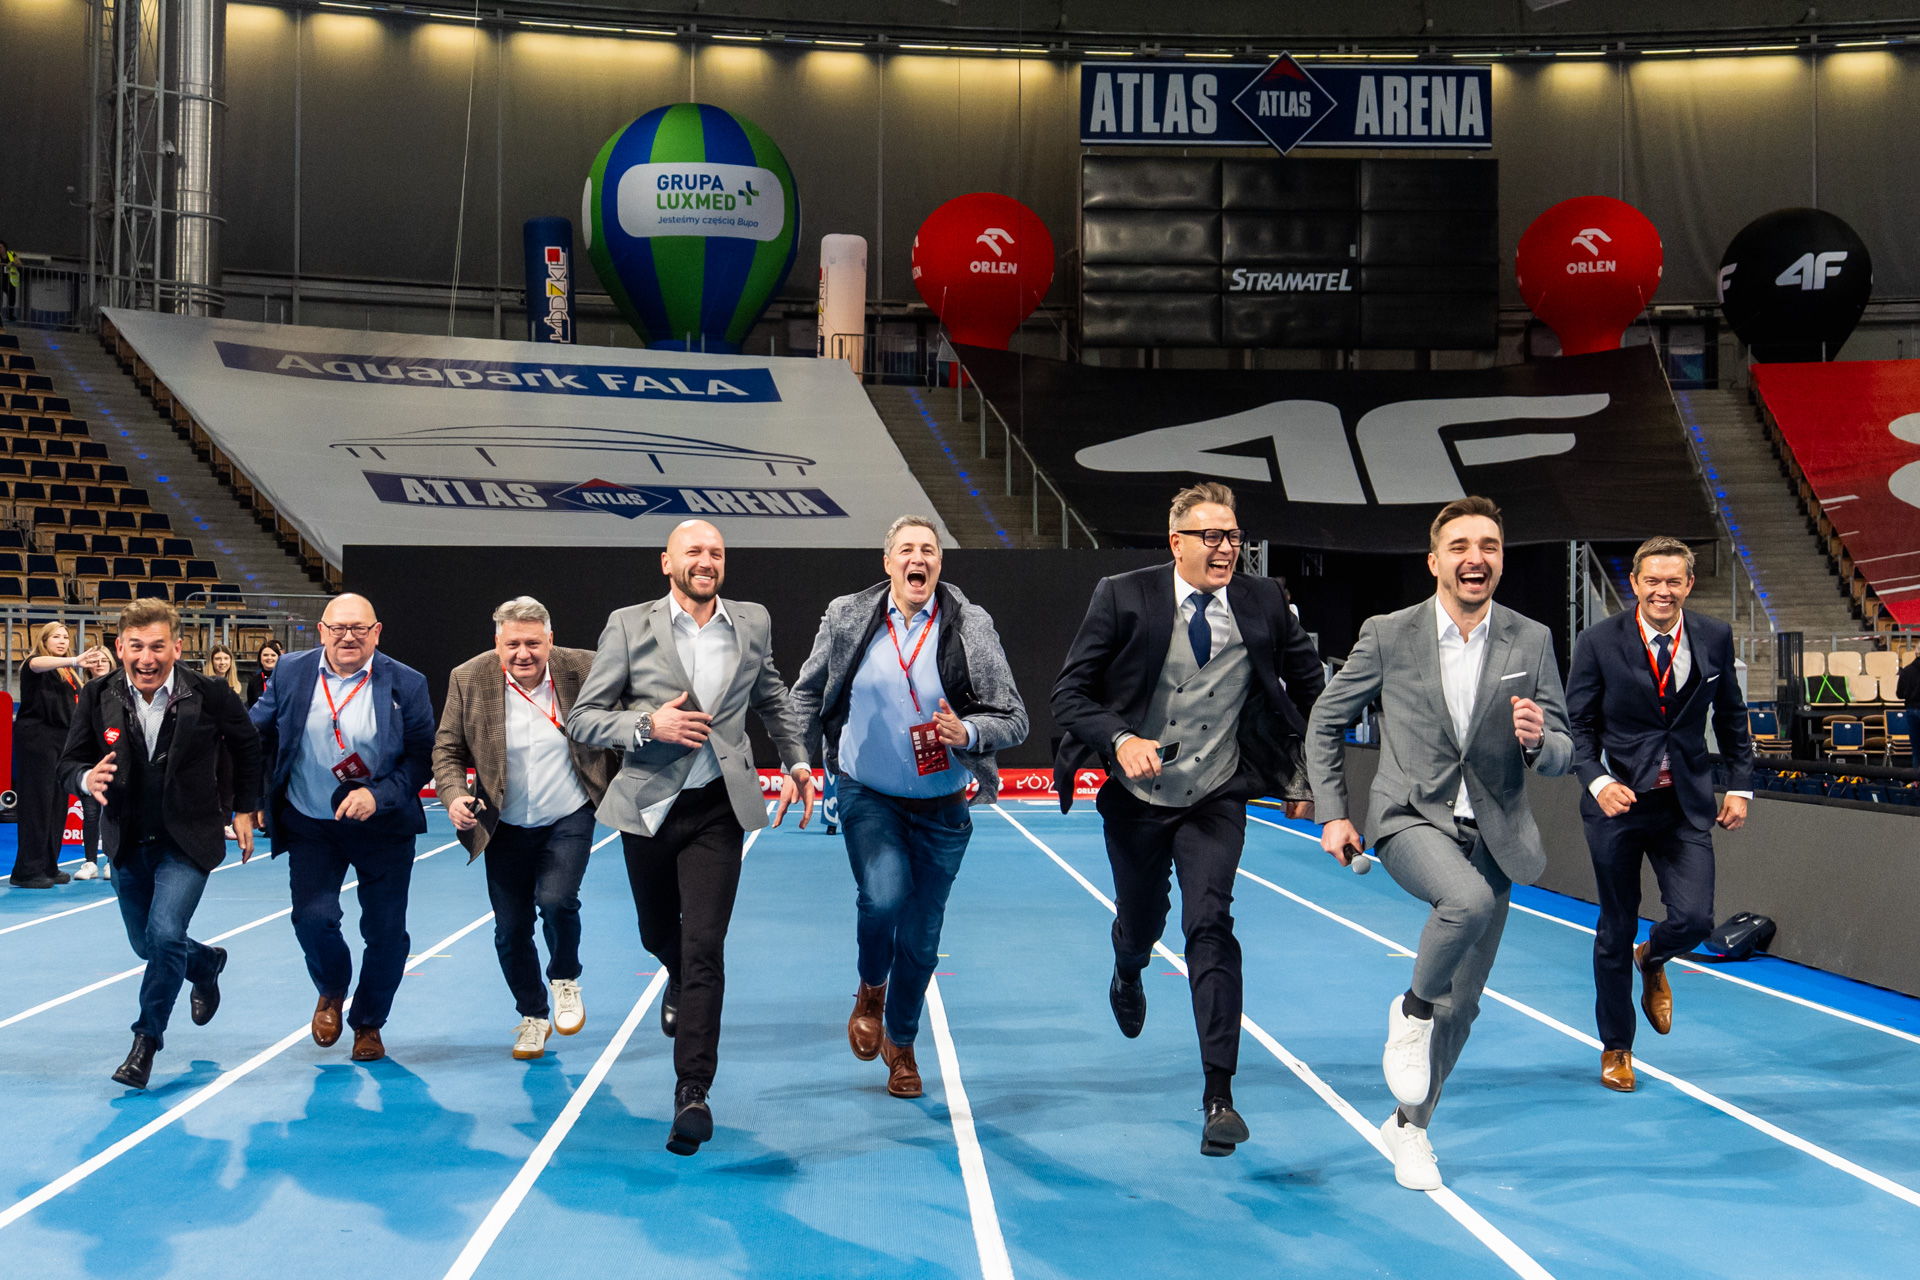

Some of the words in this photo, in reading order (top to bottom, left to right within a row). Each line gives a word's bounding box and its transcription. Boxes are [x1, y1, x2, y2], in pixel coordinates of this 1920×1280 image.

[1090, 72, 1218, 134] ATLAS
[1258, 90, 1312, 117] ATLAS
[1354, 75, 1485, 136] ARENA
[656, 173, 724, 191] GRUPA
[656, 192, 736, 211] LUXMED
[658, 214, 700, 225] Jesteśmy
[702, 215, 735, 226] częścią
[737, 217, 759, 228] Bupa
[969, 260, 1018, 275] ORLEN
[1566, 260, 1616, 275] ORLEN
[1775, 251, 1848, 290] 4F
[1229, 268, 1352, 291] STRAMATEL
[276, 354, 589, 389] Aquapark
[597, 373, 750, 396] FALA
[1075, 393, 1610, 504] 4F
[400, 478, 548, 508] ATLAS
[583, 491, 648, 506] ATLAS
[678, 489, 828, 515] ARENA
